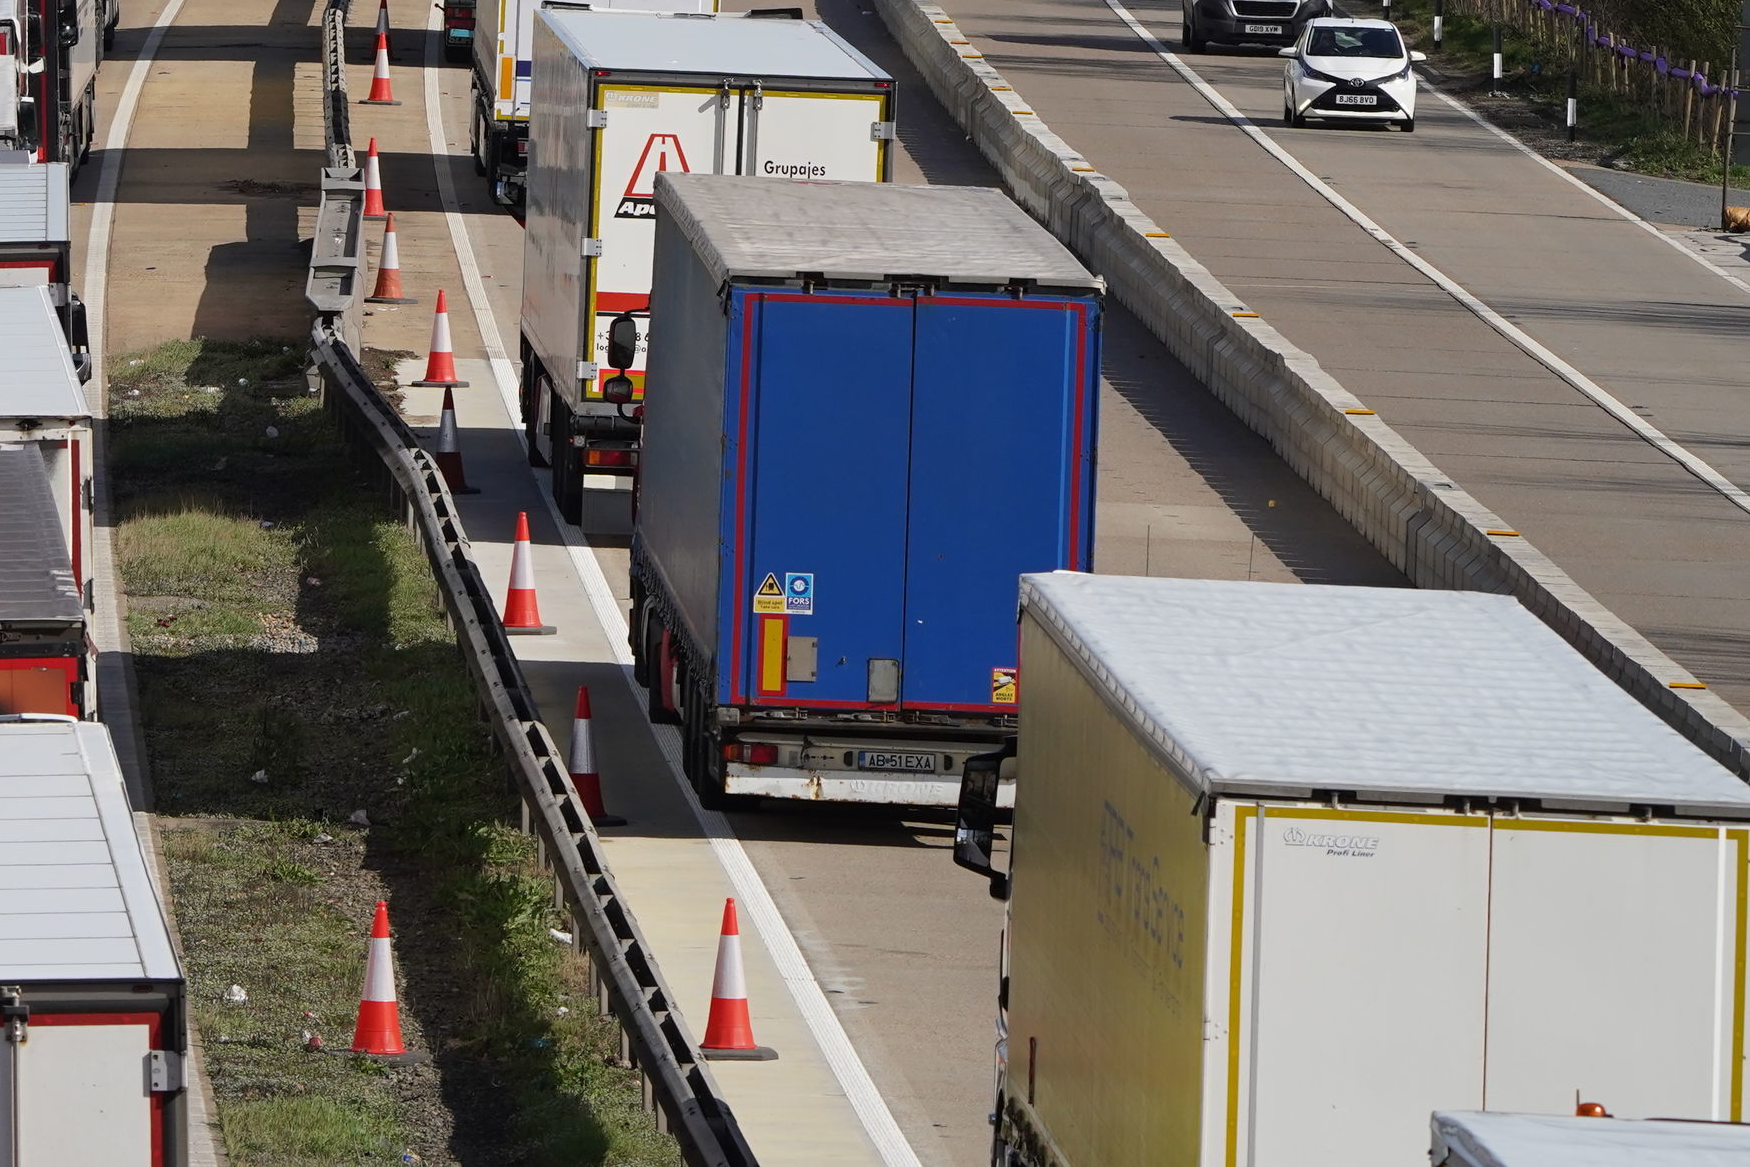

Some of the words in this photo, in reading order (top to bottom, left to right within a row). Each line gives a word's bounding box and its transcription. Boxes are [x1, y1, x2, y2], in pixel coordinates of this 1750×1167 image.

[617, 95, 658, 103] KRONE
[763, 160, 827, 179] Grupajes
[788, 597, 810, 605] FORS
[868, 754, 886, 767] AB
[890, 755, 902, 768] 51
[905, 755, 931, 769] EXA
[1306, 833, 1379, 850] KRONE
[1326, 848, 1349, 856] Profi
[1351, 849, 1375, 857] Liner
